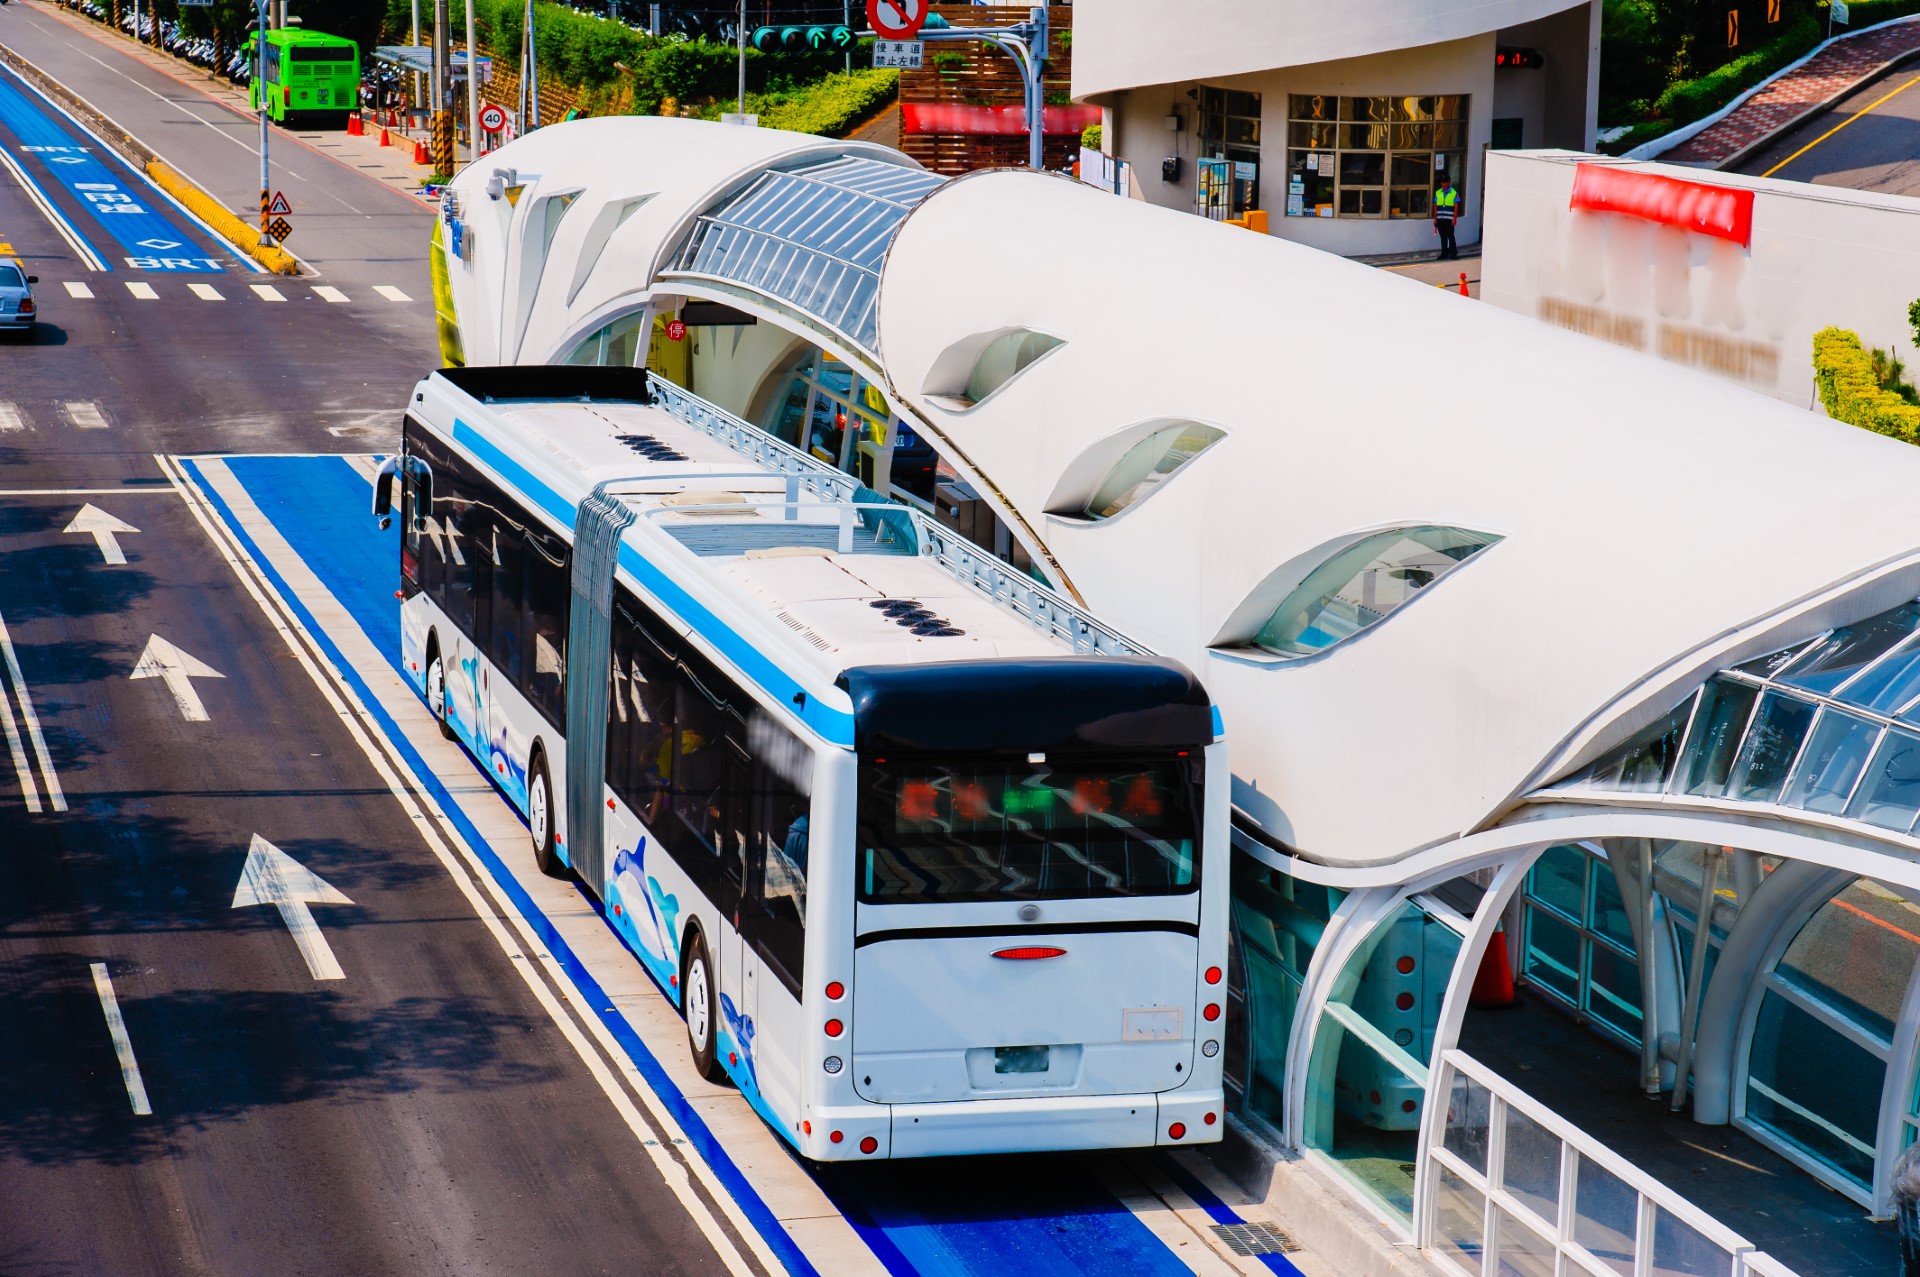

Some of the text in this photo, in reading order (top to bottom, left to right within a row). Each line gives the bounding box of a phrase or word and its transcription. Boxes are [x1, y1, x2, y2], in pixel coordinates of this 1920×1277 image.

[876, 43, 921, 54] 慢車道
[875, 56, 920, 67] 禁止左轉
[485, 114, 501, 123] 40
[20, 145, 93, 153] BRT
[124, 257, 224, 270] BRT
[669, 323, 684, 338] 停
